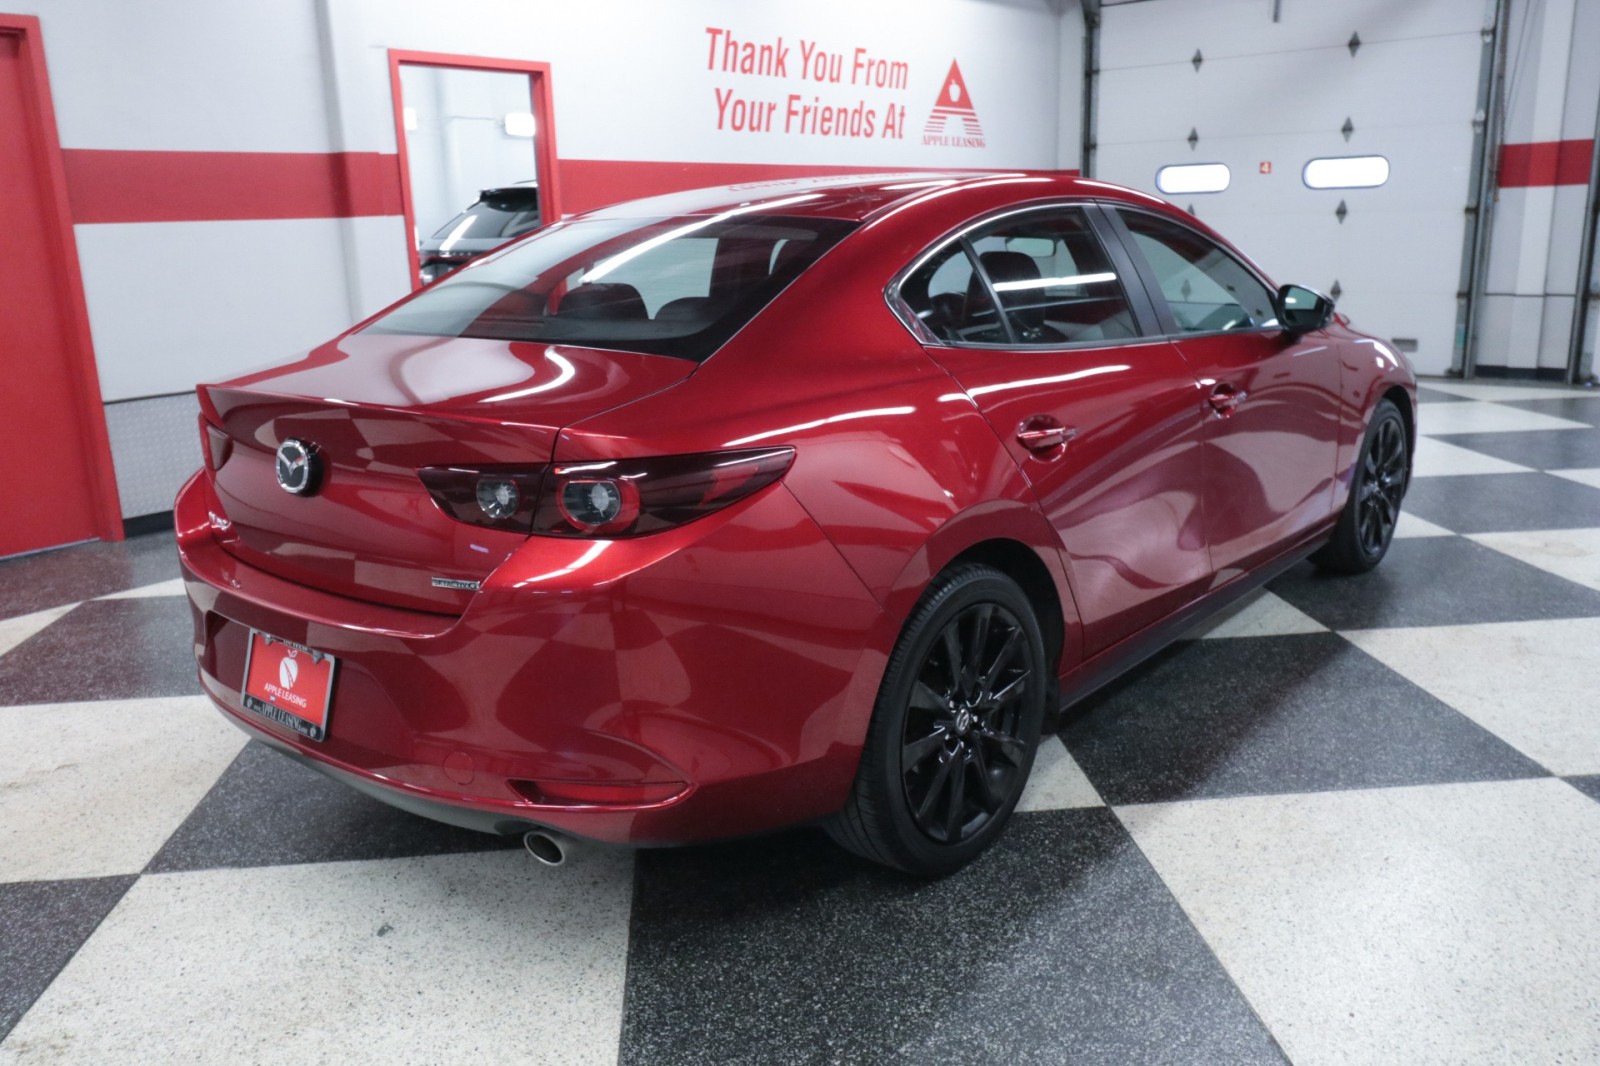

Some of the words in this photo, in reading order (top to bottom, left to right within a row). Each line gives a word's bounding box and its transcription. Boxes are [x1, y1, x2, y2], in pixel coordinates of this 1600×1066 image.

[706, 27, 789, 78] Thank
[800, 40, 842, 83] You
[851, 48, 908, 89] From
[715, 87, 777, 133] Your
[785, 94, 876, 139] Friends
[883, 102, 906, 139] At
[922, 135, 949, 146] APPLE
[951, 137, 986, 148] LEASING
[264, 682, 282, 697] APPLE
[282, 690, 307, 708] LEASING
